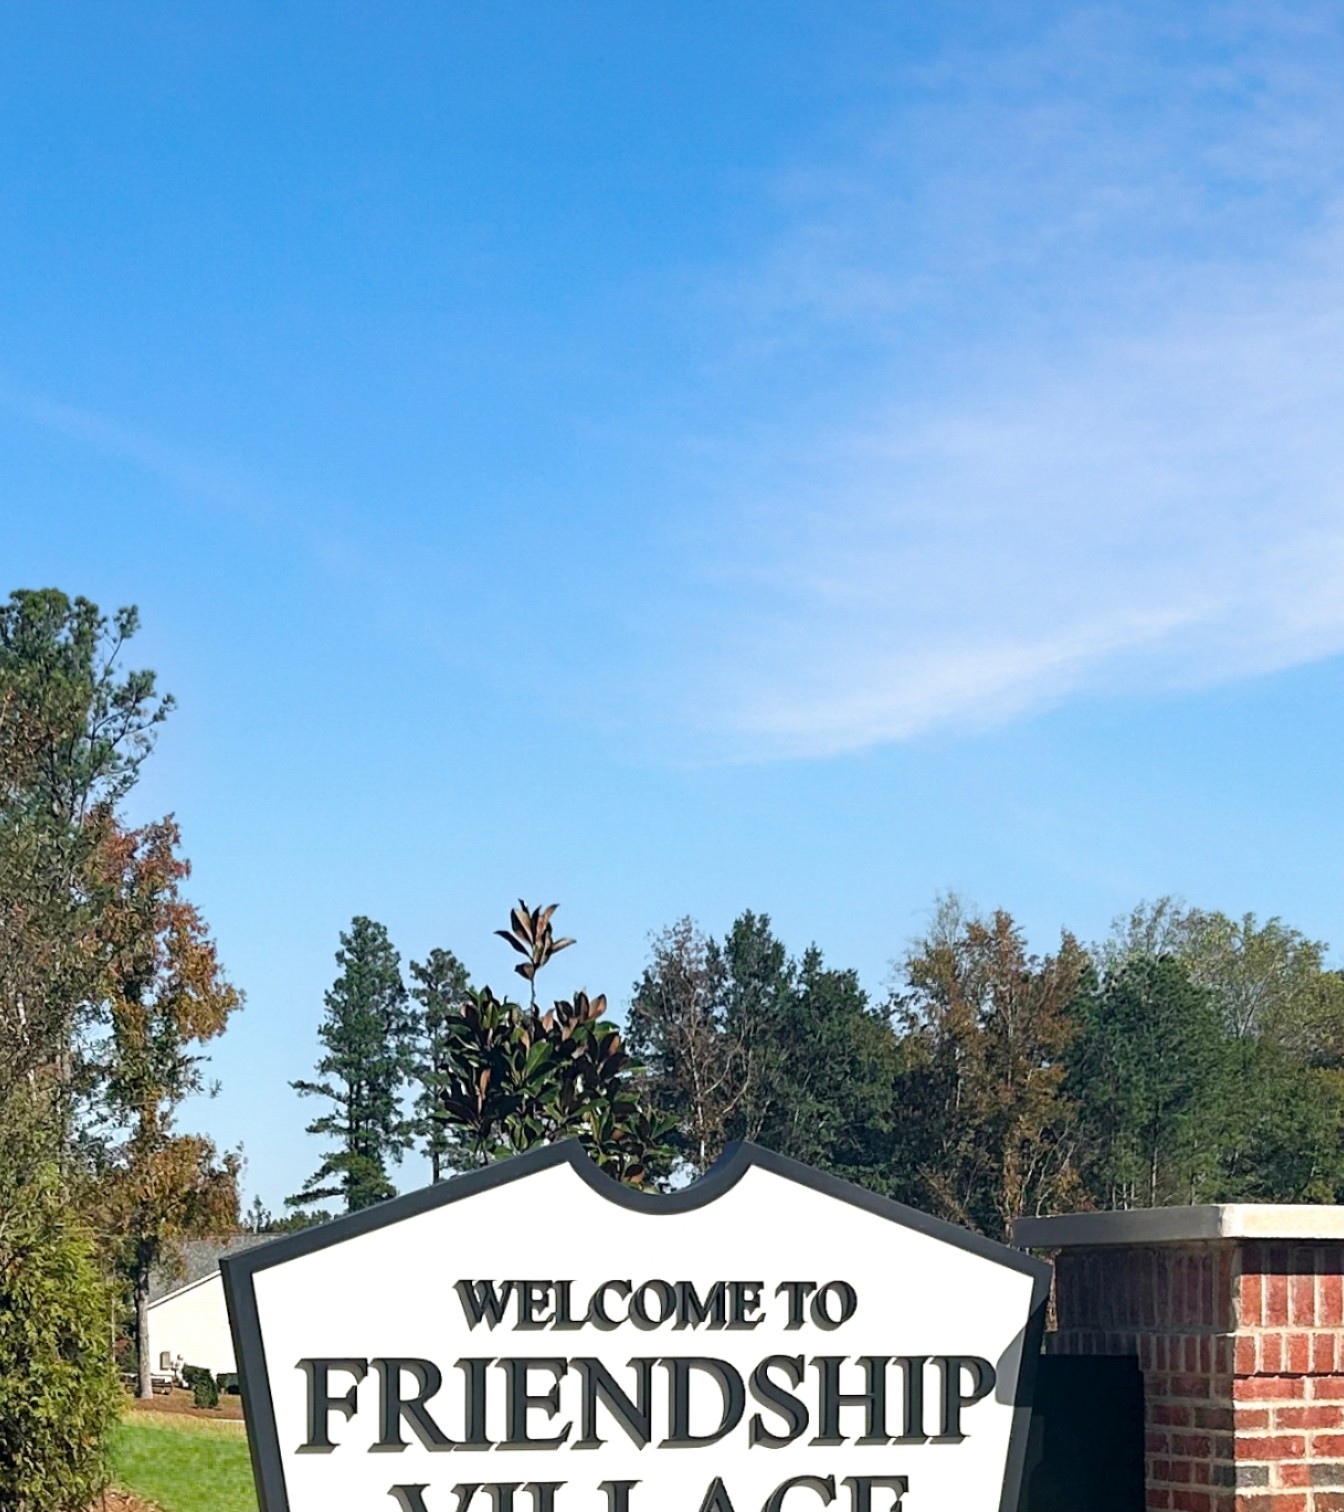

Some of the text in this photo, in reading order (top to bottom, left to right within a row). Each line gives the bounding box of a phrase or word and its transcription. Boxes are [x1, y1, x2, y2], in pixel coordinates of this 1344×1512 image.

[454, 1279, 857, 1331] WELCOME TO
[295, 1354, 997, 1454] FRIENDSHIP
